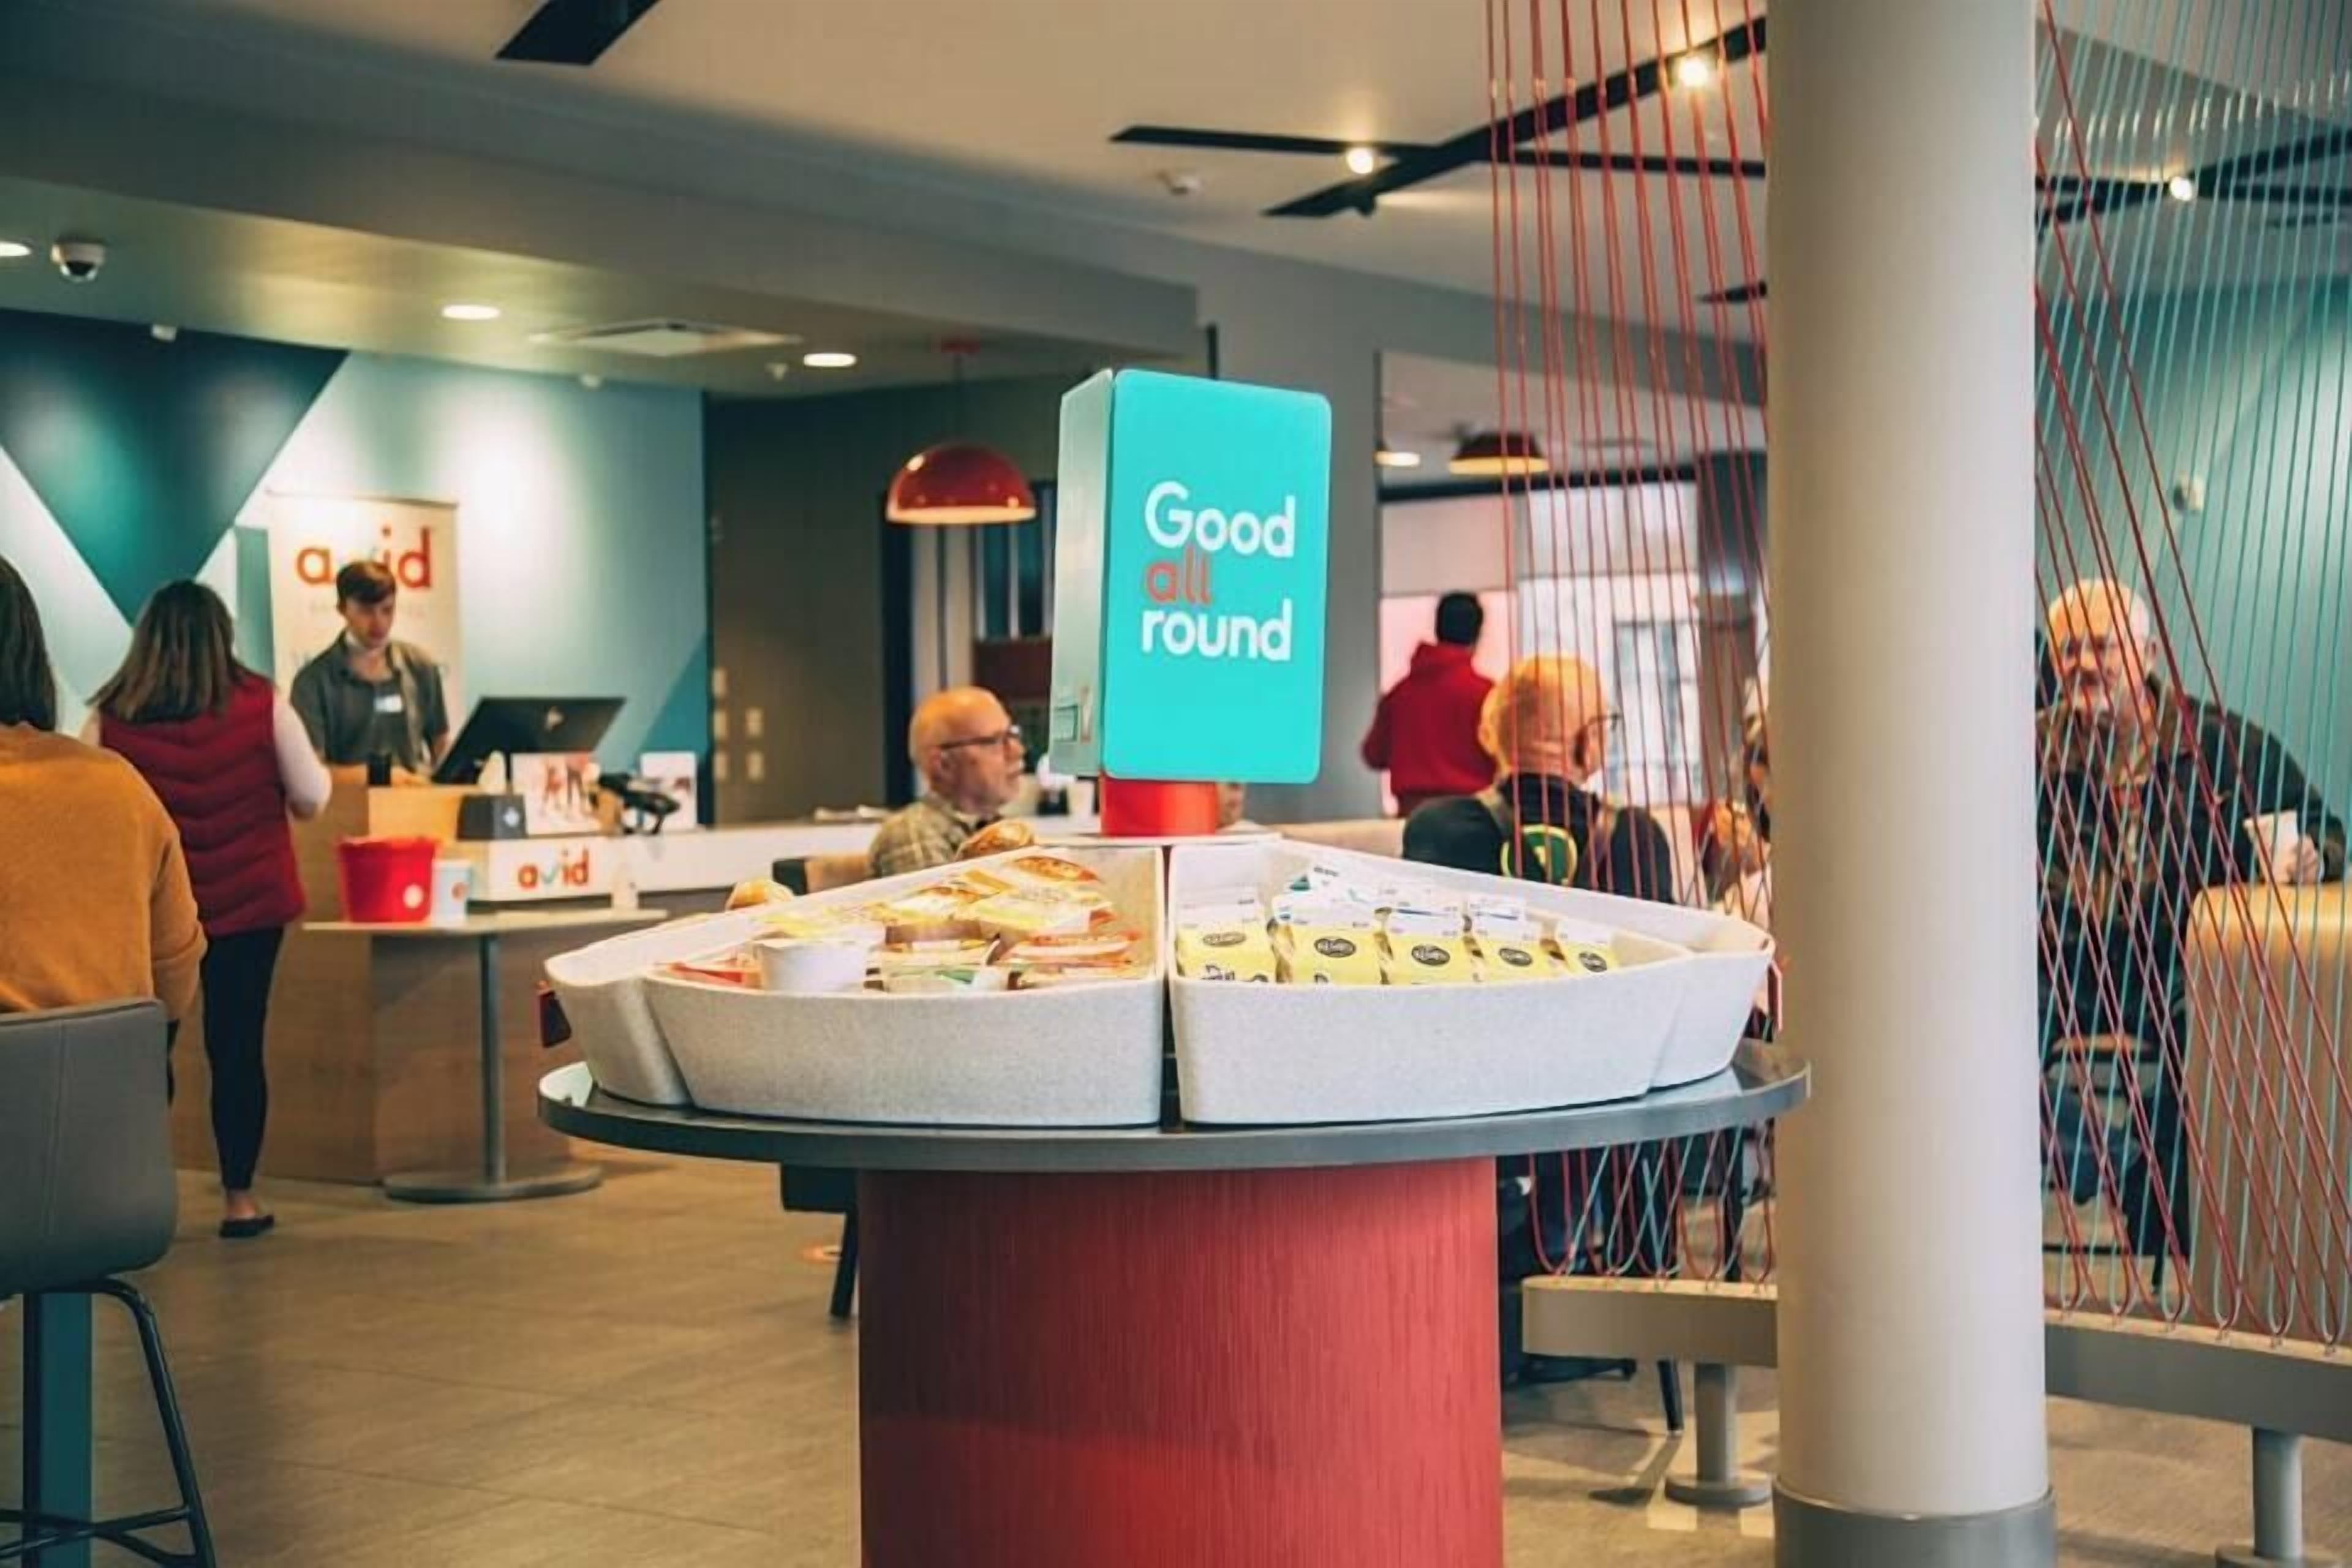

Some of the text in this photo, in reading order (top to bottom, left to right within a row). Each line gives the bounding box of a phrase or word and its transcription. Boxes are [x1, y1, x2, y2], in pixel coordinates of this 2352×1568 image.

[1145, 480, 1295, 558] Good
[296, 526, 431, 589] aid
[1145, 545, 1211, 605] all
[1142, 598, 1292, 661] round
[518, 848, 589, 889] avid
